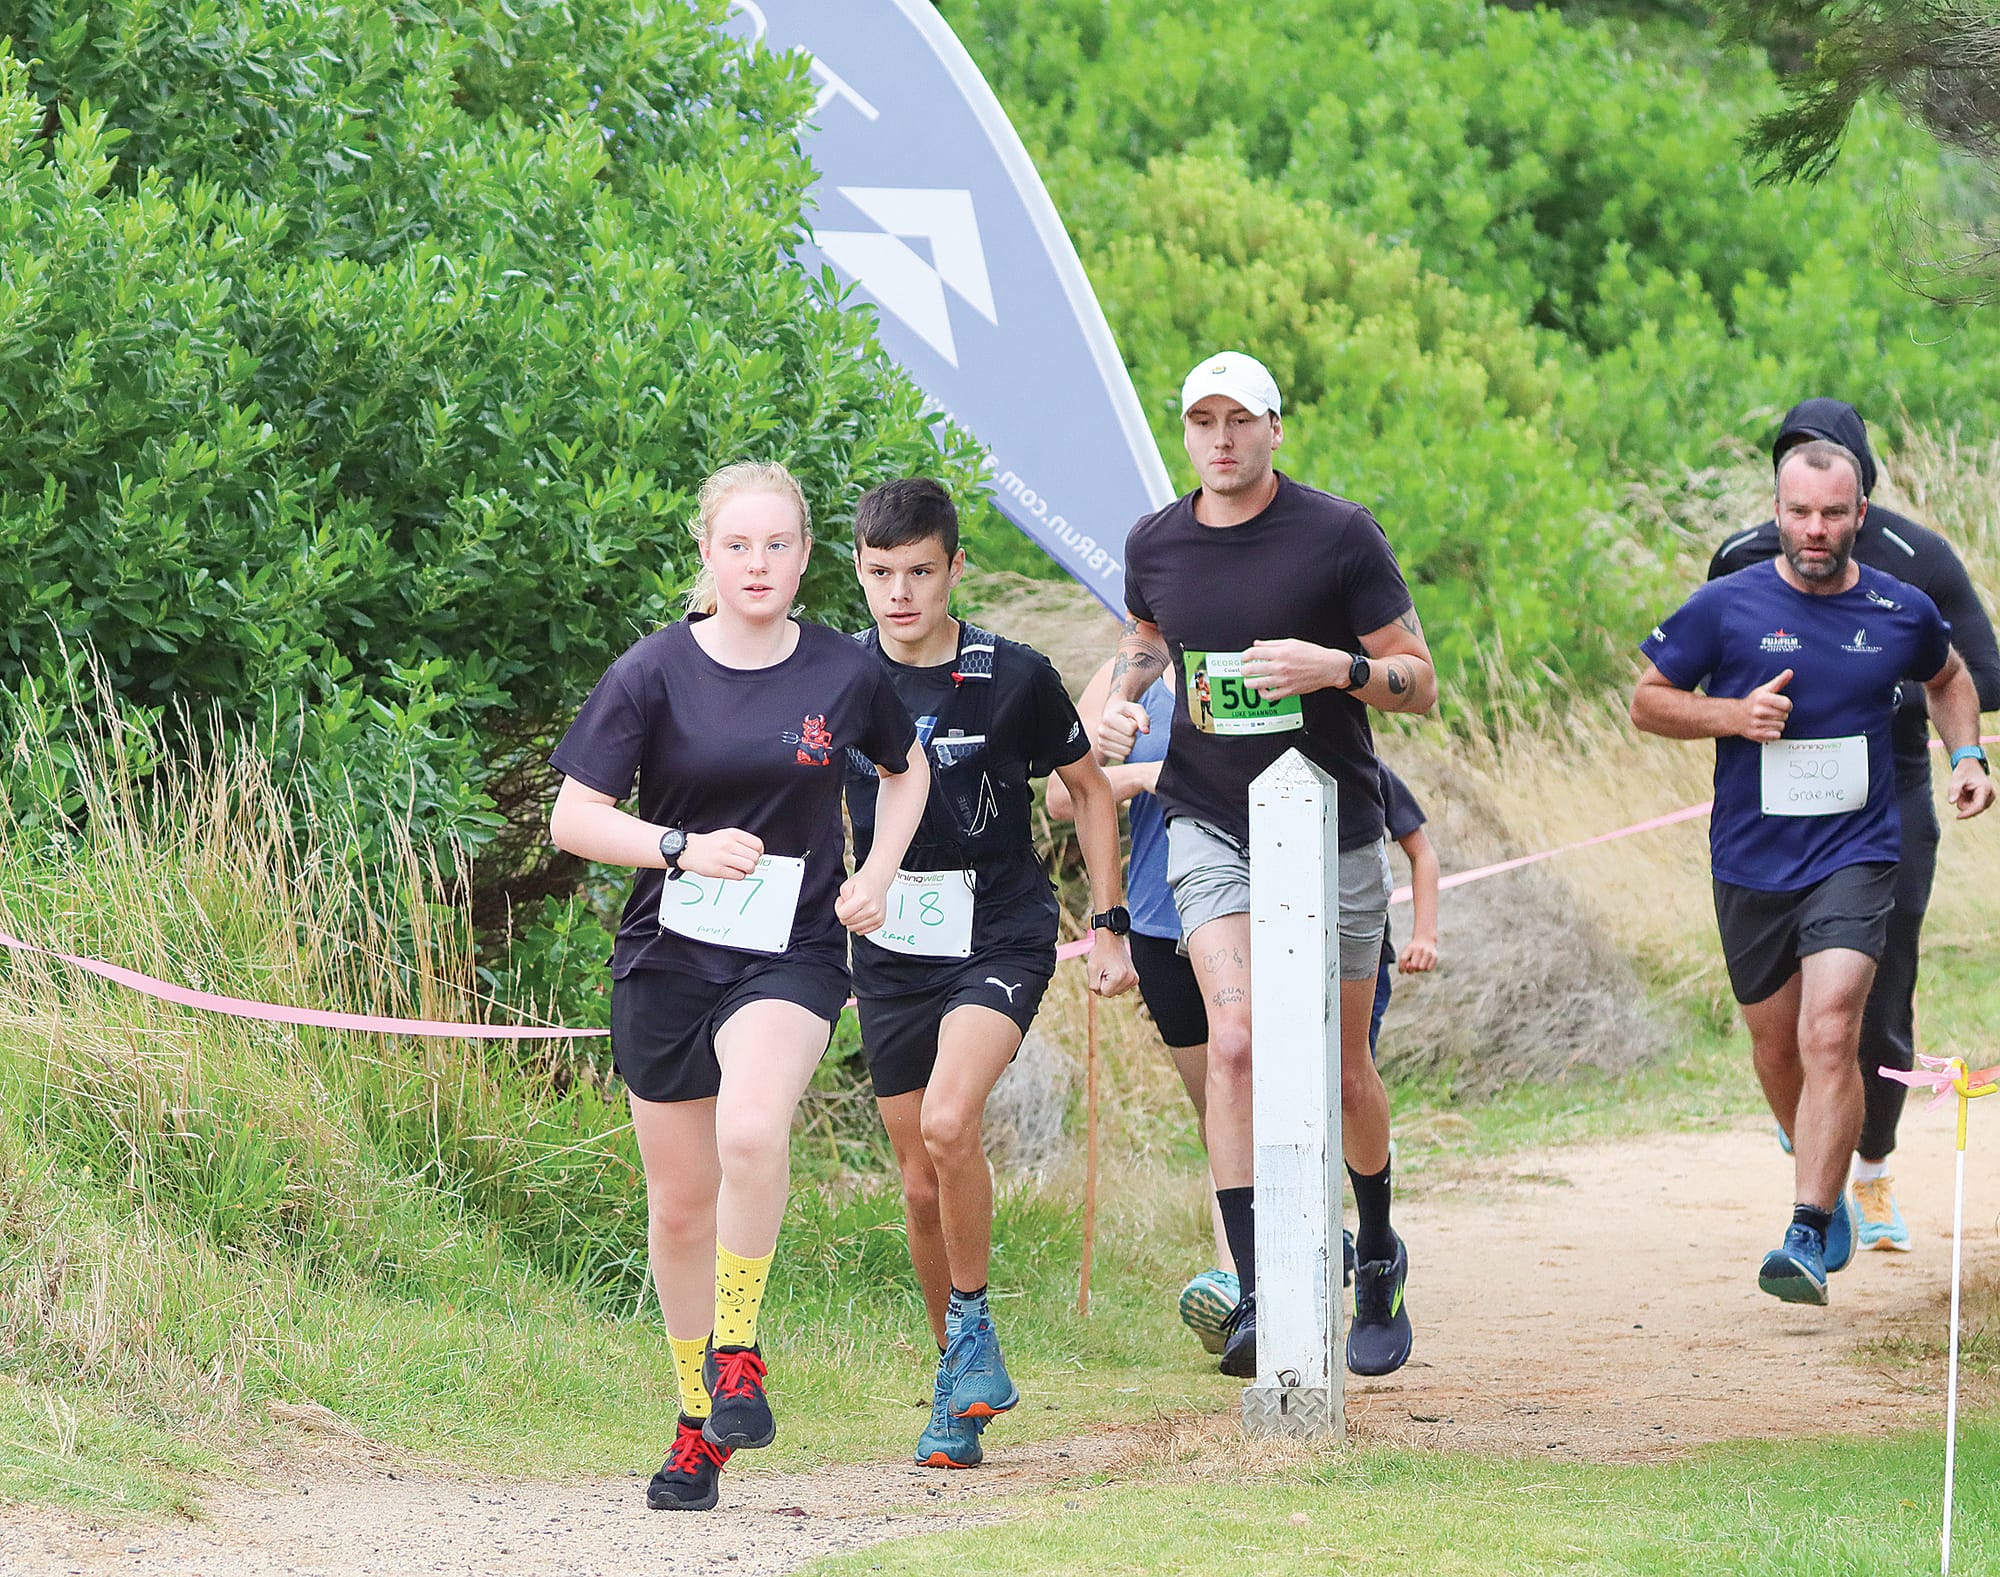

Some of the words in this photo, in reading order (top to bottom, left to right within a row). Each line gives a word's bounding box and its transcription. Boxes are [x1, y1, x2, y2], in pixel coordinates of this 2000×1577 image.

[1248, 708, 1279, 717] SHANNON
[1788, 759, 1840, 781] 520
[1788, 786, 1846, 801] Graeme
[678, 877, 764, 916] 517
[898, 890, 945, 926] 18
